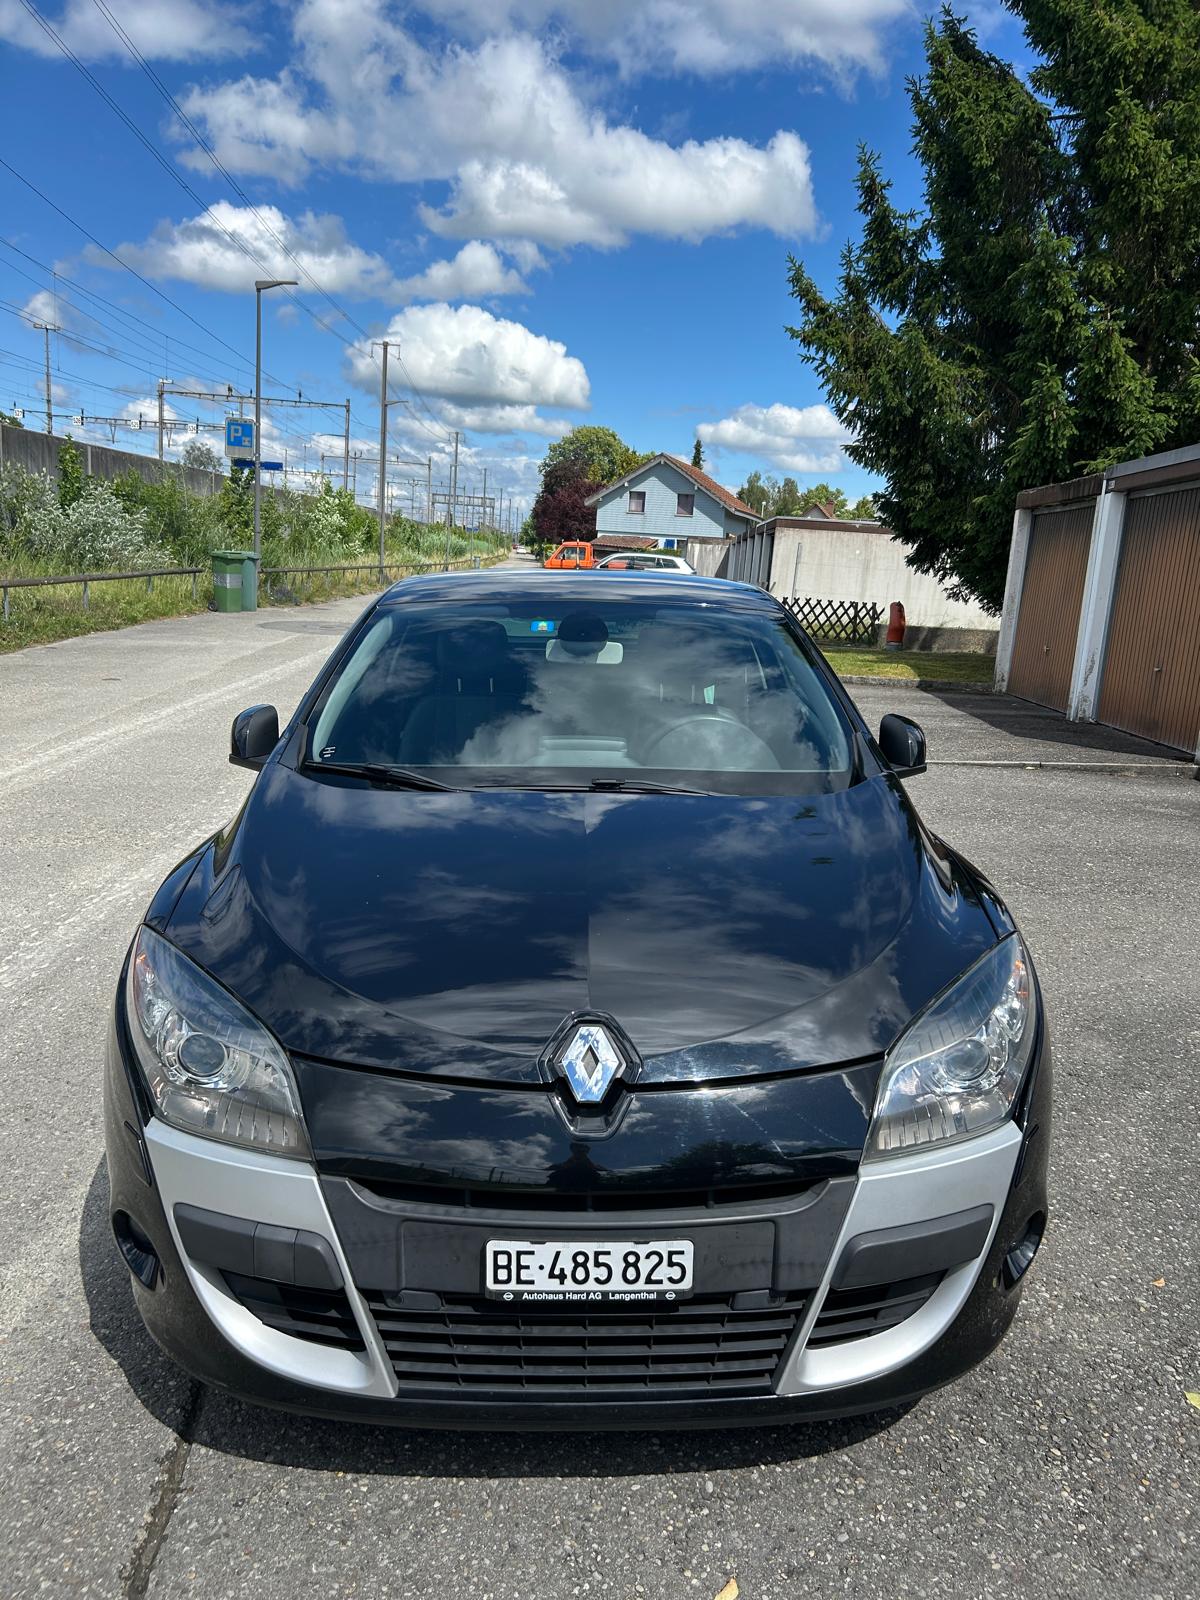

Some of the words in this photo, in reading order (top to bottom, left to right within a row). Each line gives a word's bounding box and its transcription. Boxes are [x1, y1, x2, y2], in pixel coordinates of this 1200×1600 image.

[230, 425, 242, 442] P
[522, 1292, 564, 1300] Autohaus
[565, 1292, 587, 1300] Hard
[588, 1292, 602, 1300] AG
[609, 1291, 657, 1301] Langenthal
